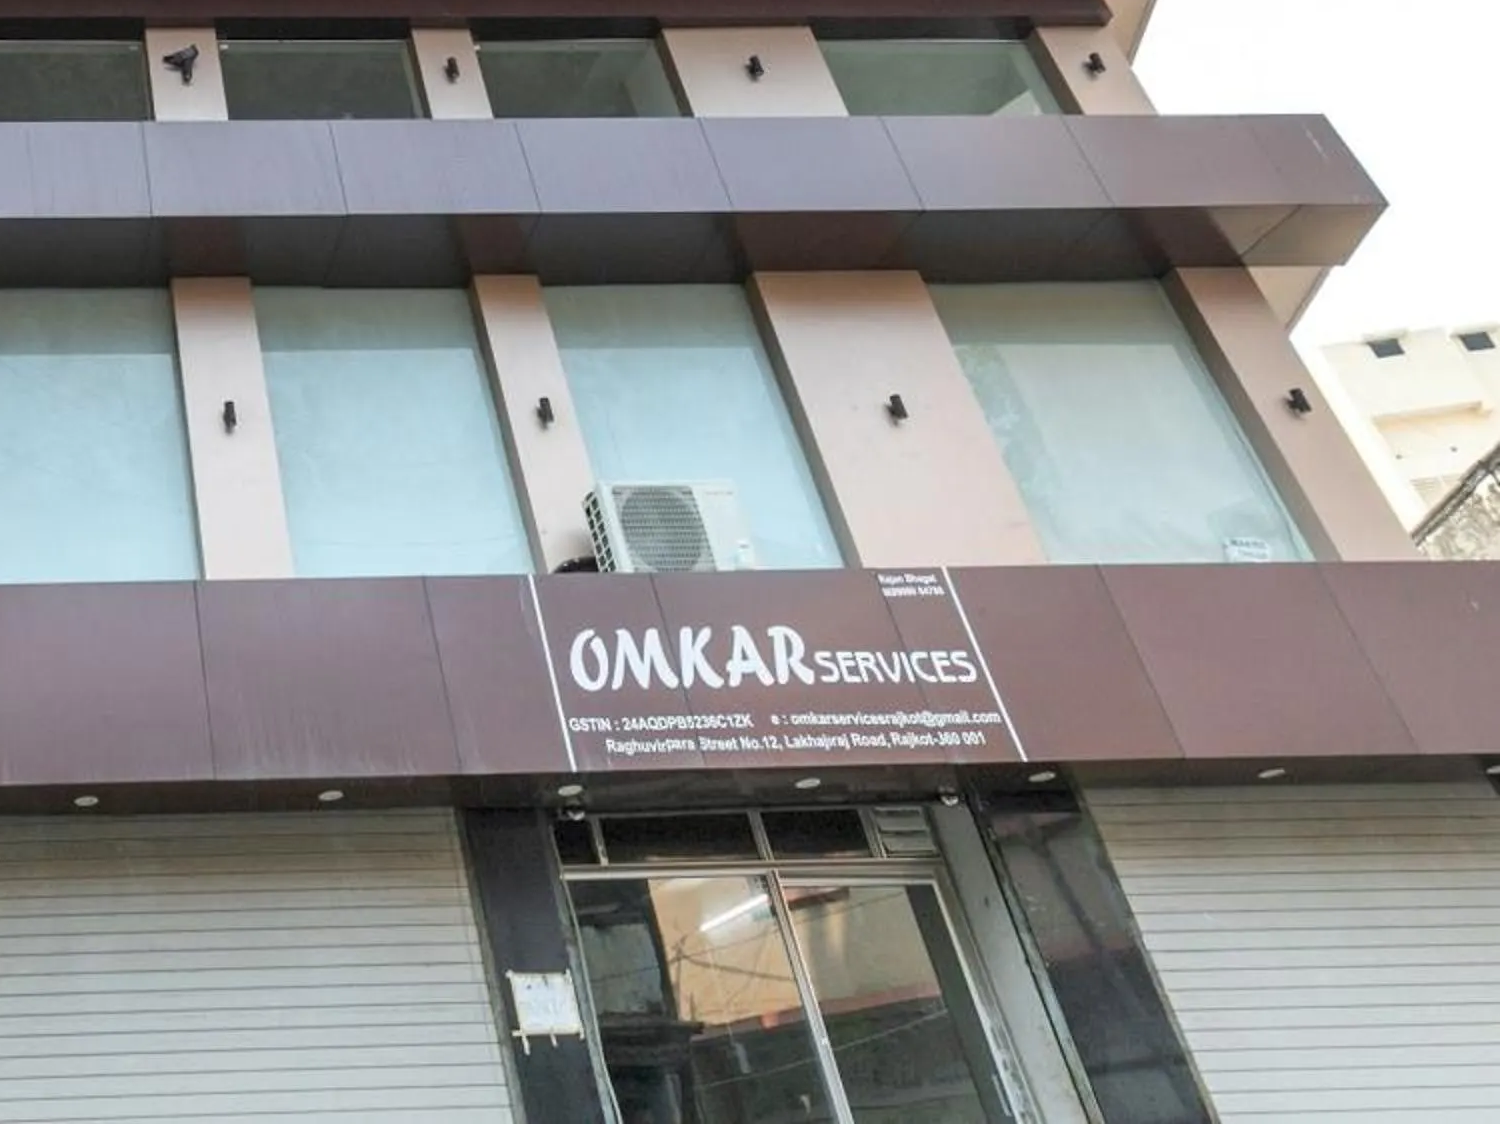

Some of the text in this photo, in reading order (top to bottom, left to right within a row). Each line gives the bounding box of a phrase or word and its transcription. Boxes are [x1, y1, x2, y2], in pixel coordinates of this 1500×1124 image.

[570, 625, 977, 692] OMKAR SERVICES
[569, 716, 612, 732] GSTIN
[698, 735, 738, 751] Street
[850, 731, 892, 749] Road,
